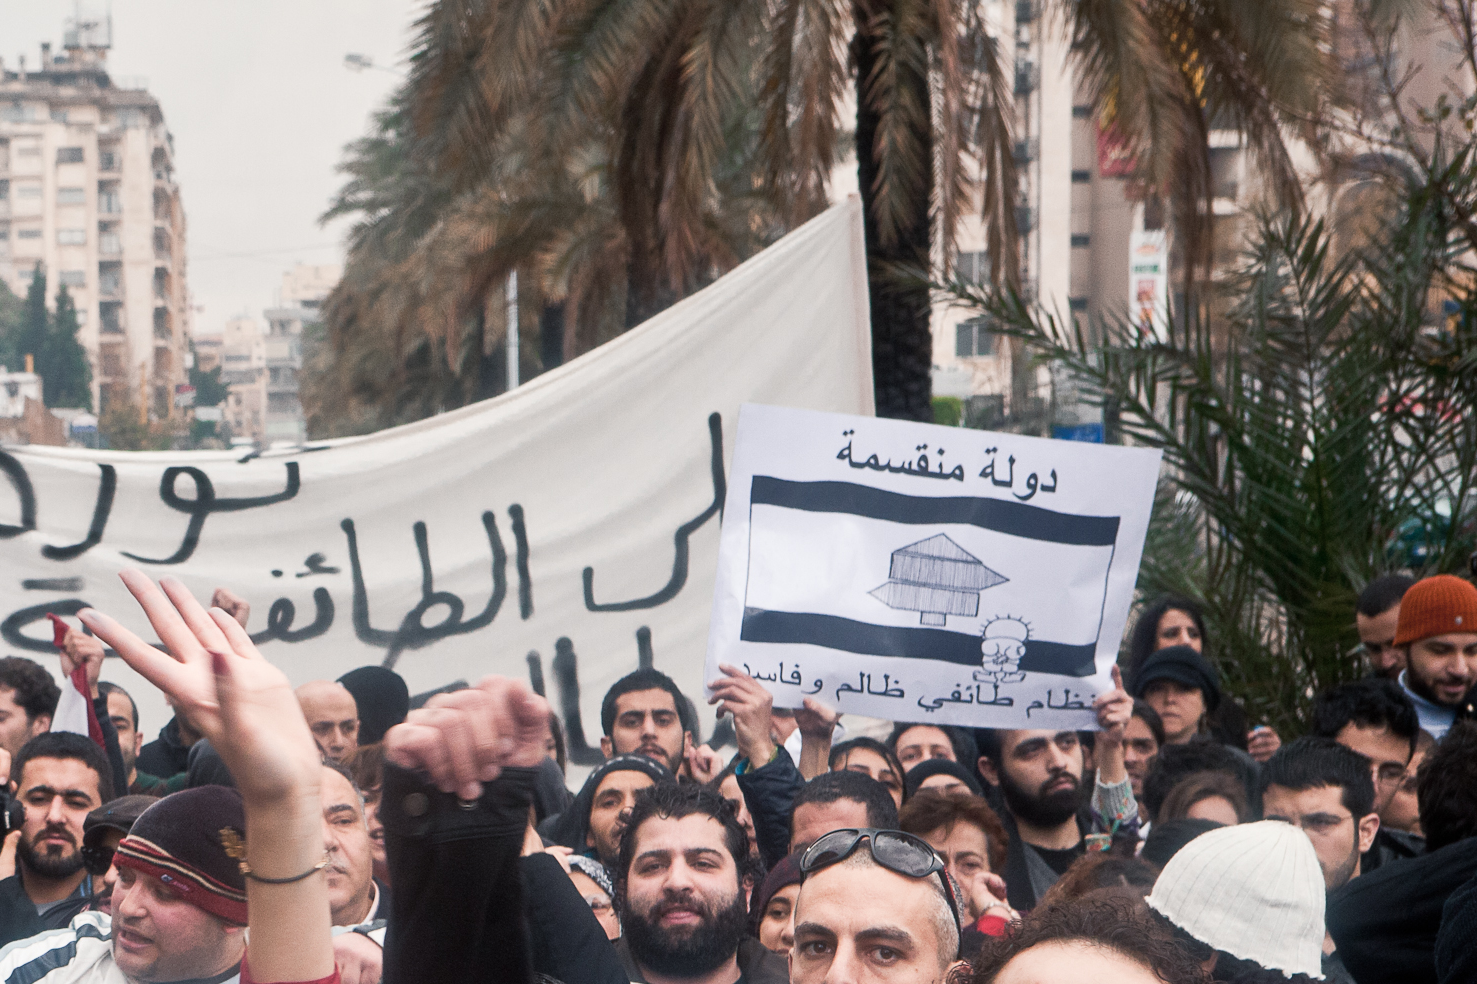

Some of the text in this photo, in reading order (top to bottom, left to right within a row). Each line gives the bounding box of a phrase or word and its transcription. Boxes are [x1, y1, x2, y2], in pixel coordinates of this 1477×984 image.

[836, 429, 1057, 501] دولة منقسمة
[0, 503, 533, 670] الطائفة
[835, 672, 905, 702] ظالم
[918, 684, 1014, 713] طائفي
